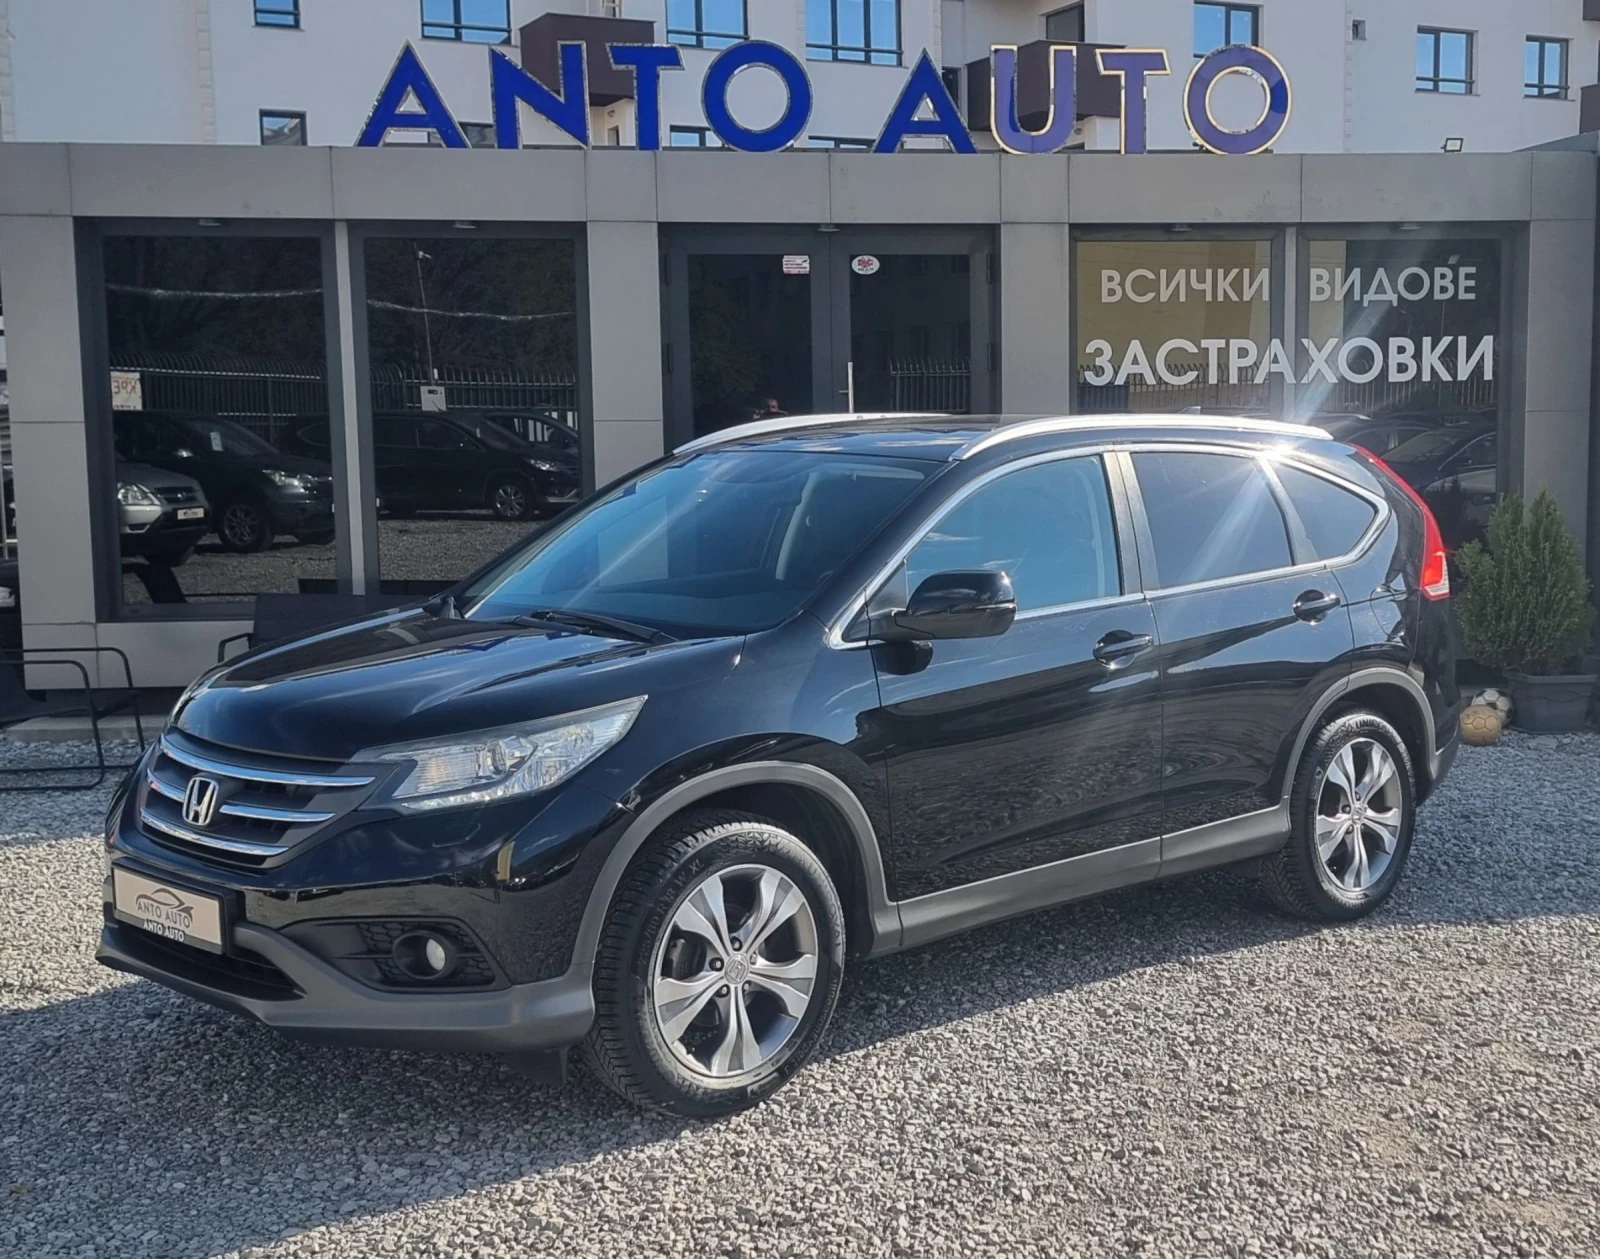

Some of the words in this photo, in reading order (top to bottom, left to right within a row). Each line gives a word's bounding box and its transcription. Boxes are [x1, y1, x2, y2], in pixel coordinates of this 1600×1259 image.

[353, 38, 814, 153] ANTO
[872, 44, 1293, 155] AUTO
[1101, 267, 1270, 303] ВСИЧКИ
[1309, 265, 1477, 307] ВИДОВЕ
[1083, 335, 1495, 386] ЗАСТРАХОВКИ
[137, 900, 162, 919] ANTO
[165, 909, 191, 929] AUTO
[142, 919, 164, 935] ANTO
[164, 926, 185, 942] AUTO
